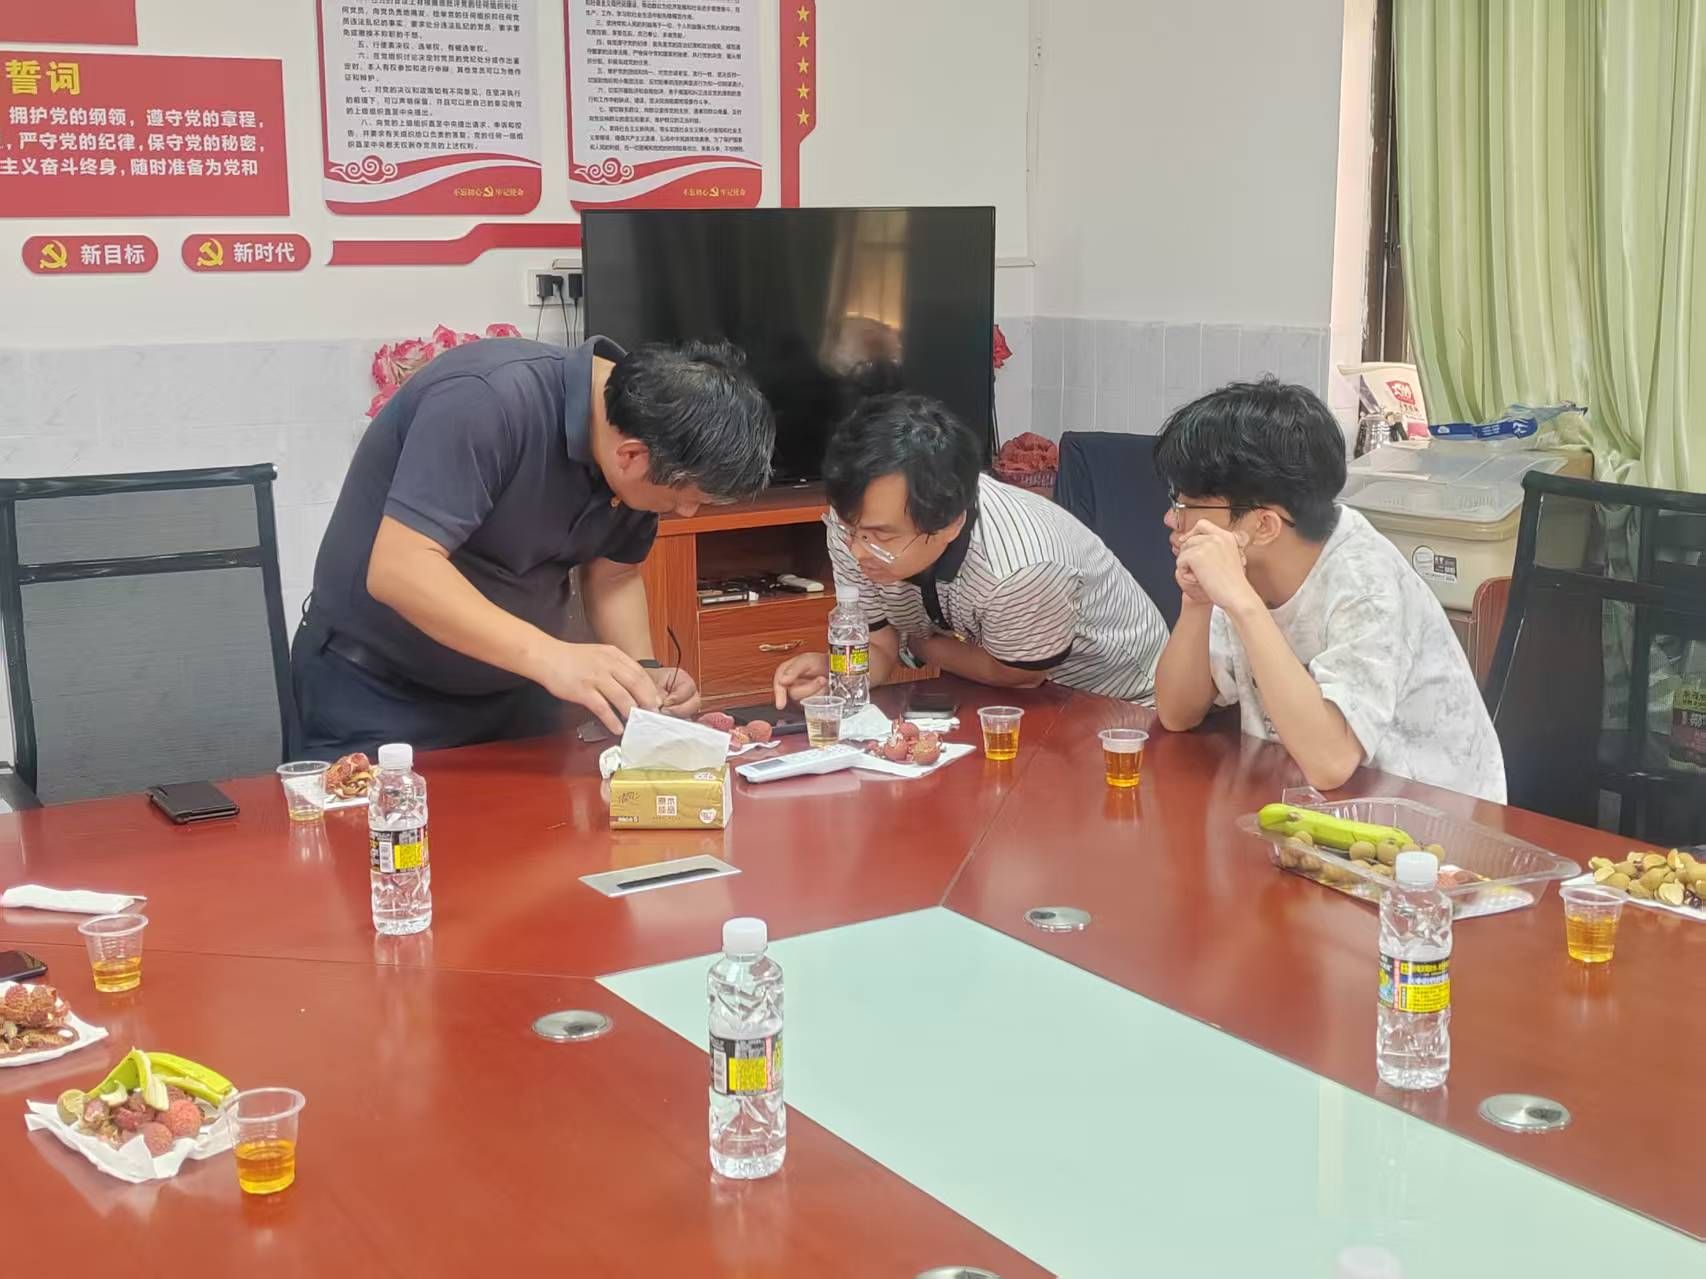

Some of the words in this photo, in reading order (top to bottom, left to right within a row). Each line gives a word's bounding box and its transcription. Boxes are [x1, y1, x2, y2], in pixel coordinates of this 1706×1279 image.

[5, 59, 80, 96] 誓词
[0, 132, 265, 152] ，严守党的纪律，保守党的秘密，
[0, 157, 258, 176] 主义奋斗终身，随时准备为党和
[80, 244, 145, 265] 新目标
[233, 242, 296, 263] 新时代
